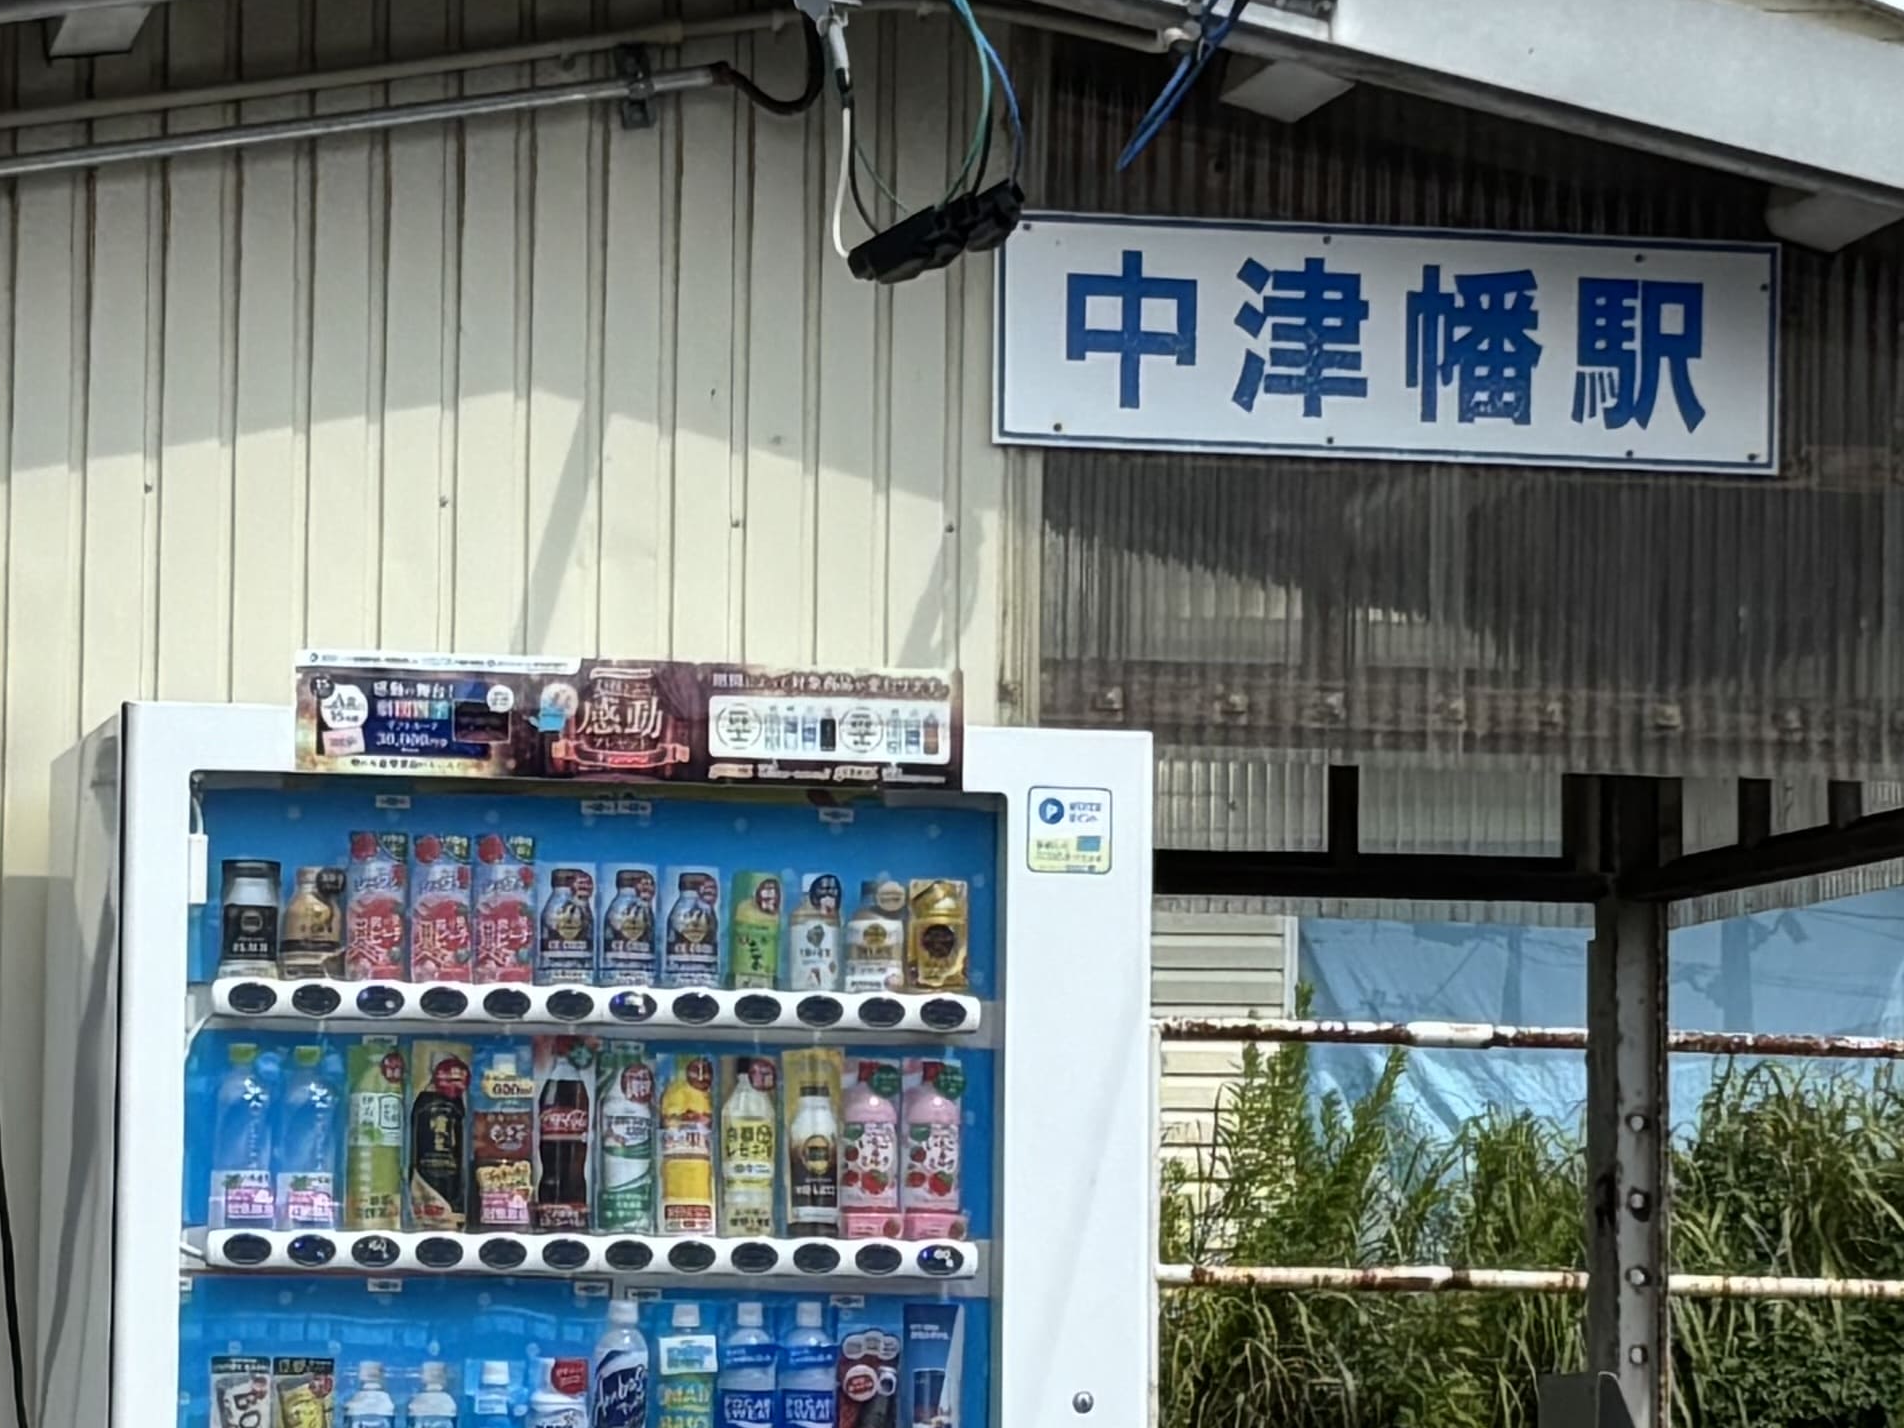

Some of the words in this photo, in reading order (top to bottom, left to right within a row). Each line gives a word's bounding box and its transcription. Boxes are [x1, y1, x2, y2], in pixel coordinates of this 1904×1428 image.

[1066, 249, 1706, 433] 中津幡駅
[576, 696, 663, 739] 感動
